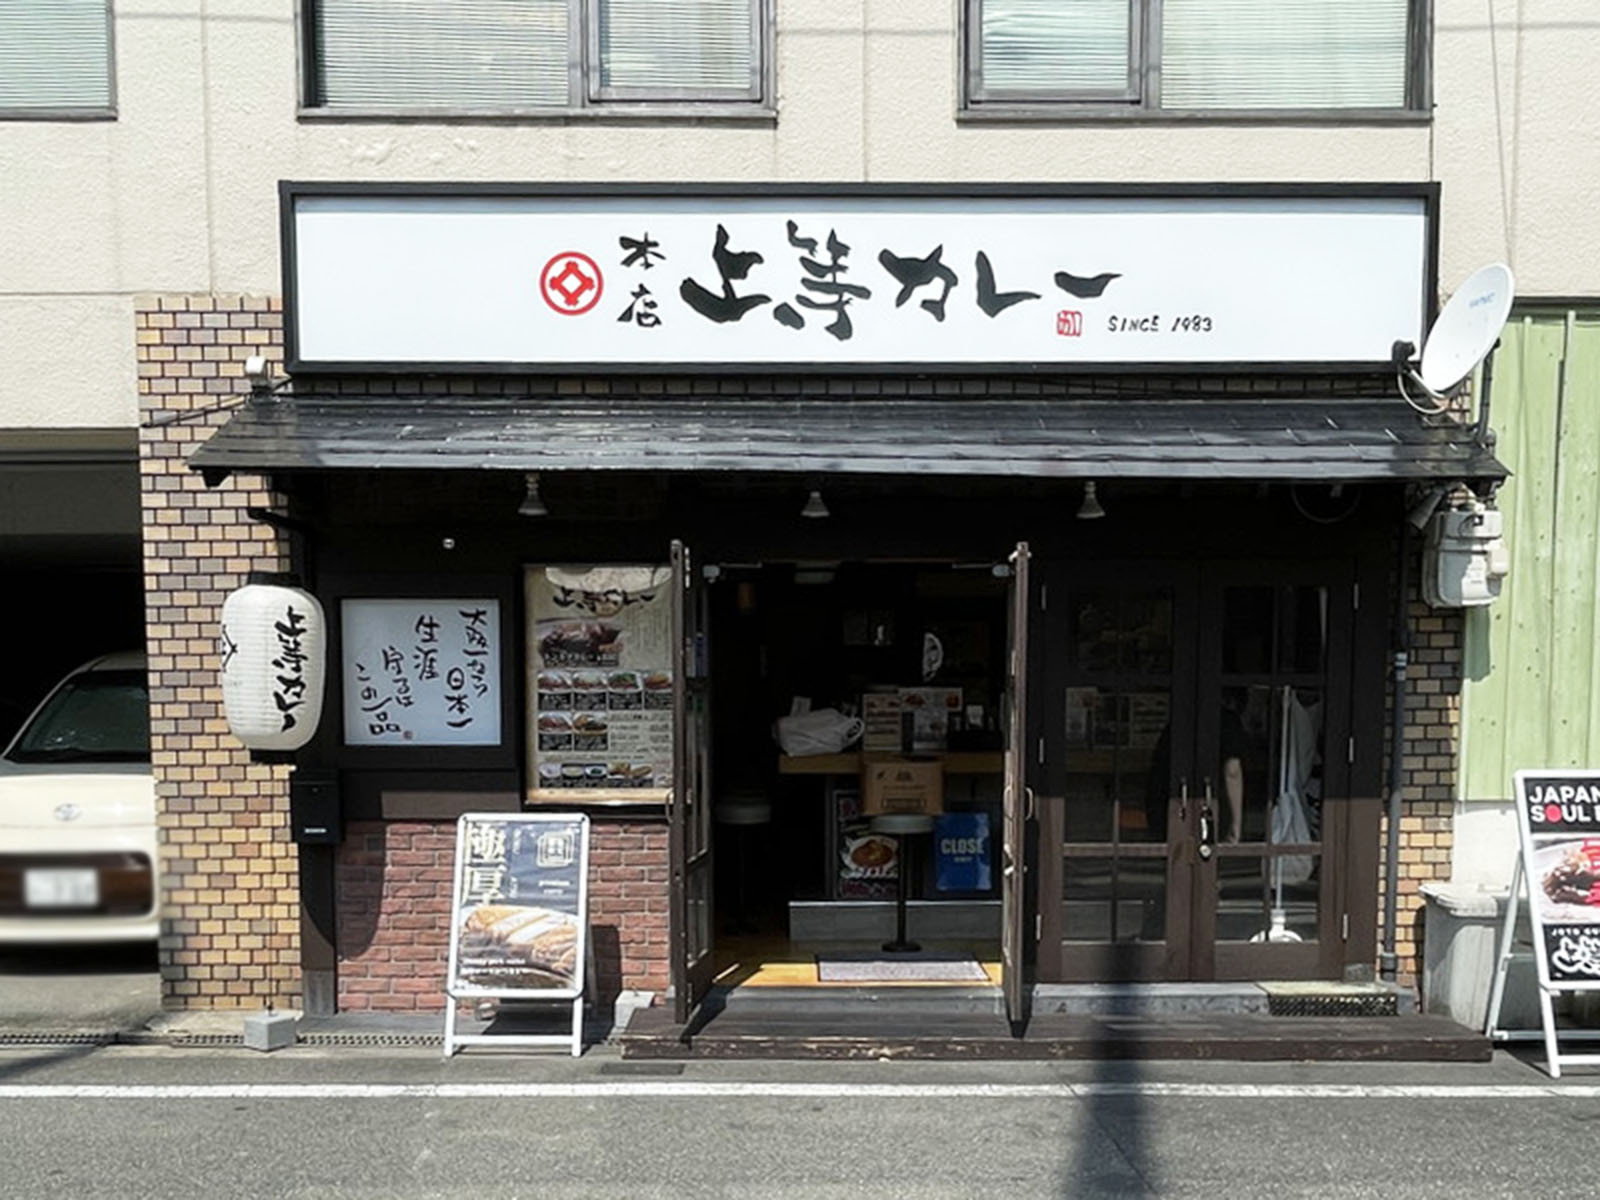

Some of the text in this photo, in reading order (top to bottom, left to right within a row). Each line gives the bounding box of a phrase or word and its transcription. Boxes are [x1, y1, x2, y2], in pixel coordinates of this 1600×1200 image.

[617, 232, 666, 328] 本店
[680, 219, 1122, 341] 上等カレー
[1108, 315, 1213, 333] SINCE 1983
[940, 837, 985, 856] CLOSE
